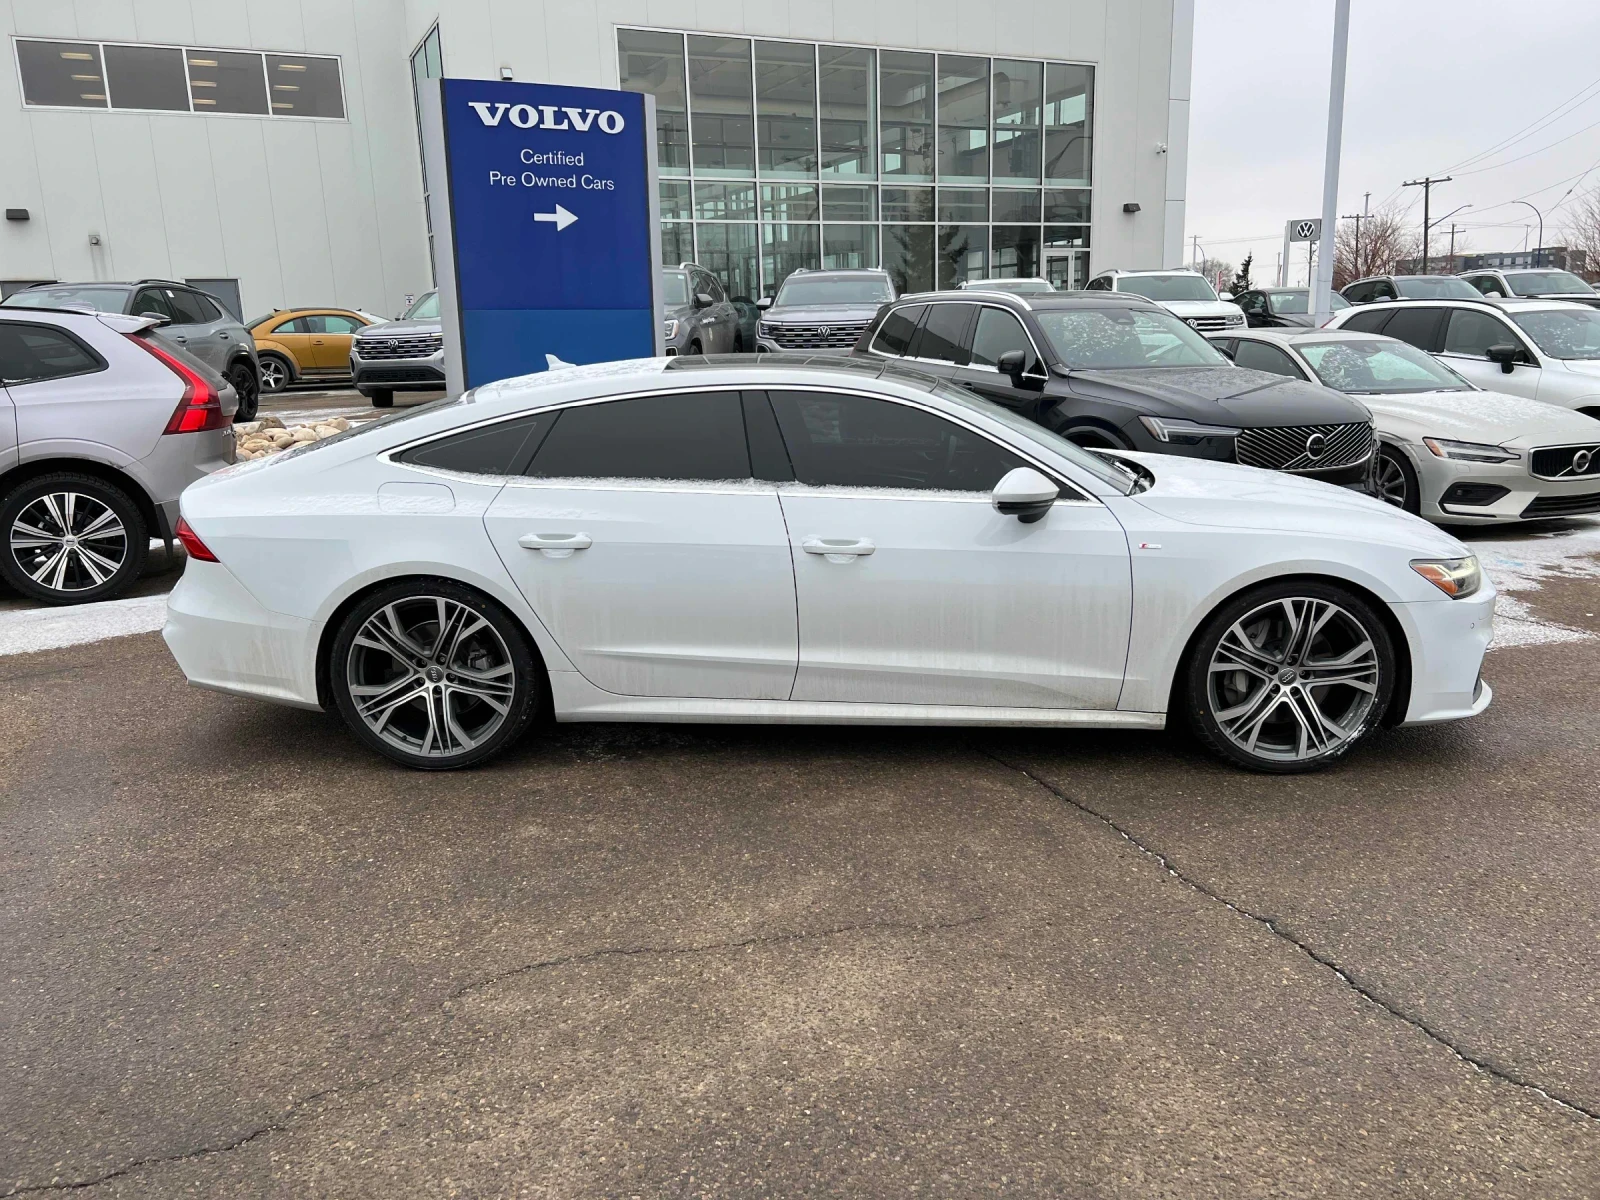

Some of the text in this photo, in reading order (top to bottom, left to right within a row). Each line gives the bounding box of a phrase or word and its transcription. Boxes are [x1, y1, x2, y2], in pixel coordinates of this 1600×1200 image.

[468, 101, 625, 135] VOLVO
[520, 148, 584, 167] Certified
[489, 171, 615, 191] Pre Owned Cars
